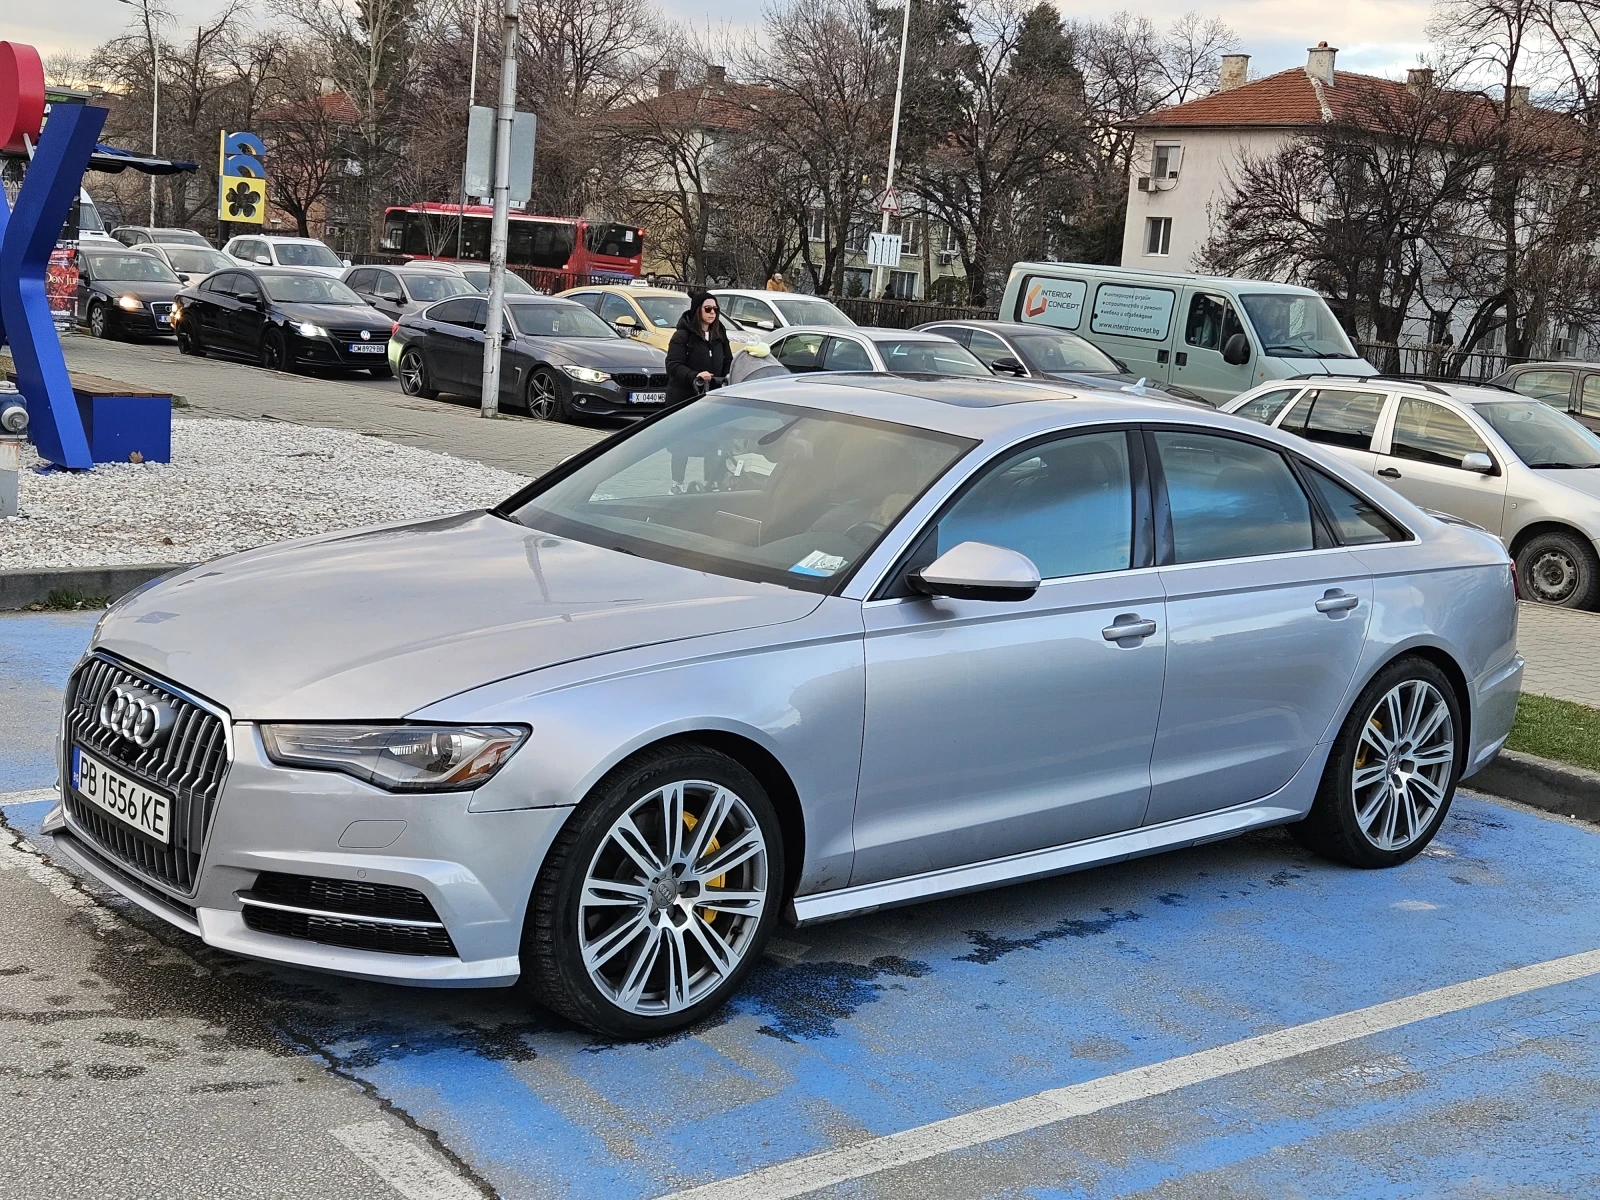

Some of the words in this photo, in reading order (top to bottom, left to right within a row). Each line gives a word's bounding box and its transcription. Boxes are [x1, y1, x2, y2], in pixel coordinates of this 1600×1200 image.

[1041, 289, 1072, 299] INTERIOR
[1047, 300, 1080, 310] CONCEPT
[1098, 322, 1160, 336] www.interiorconcept.bg
[643, 393, 657, 401] 0440
[80, 756, 97, 797] PB
[101, 771, 137, 821] 1556
[140, 792, 166, 837] KE
